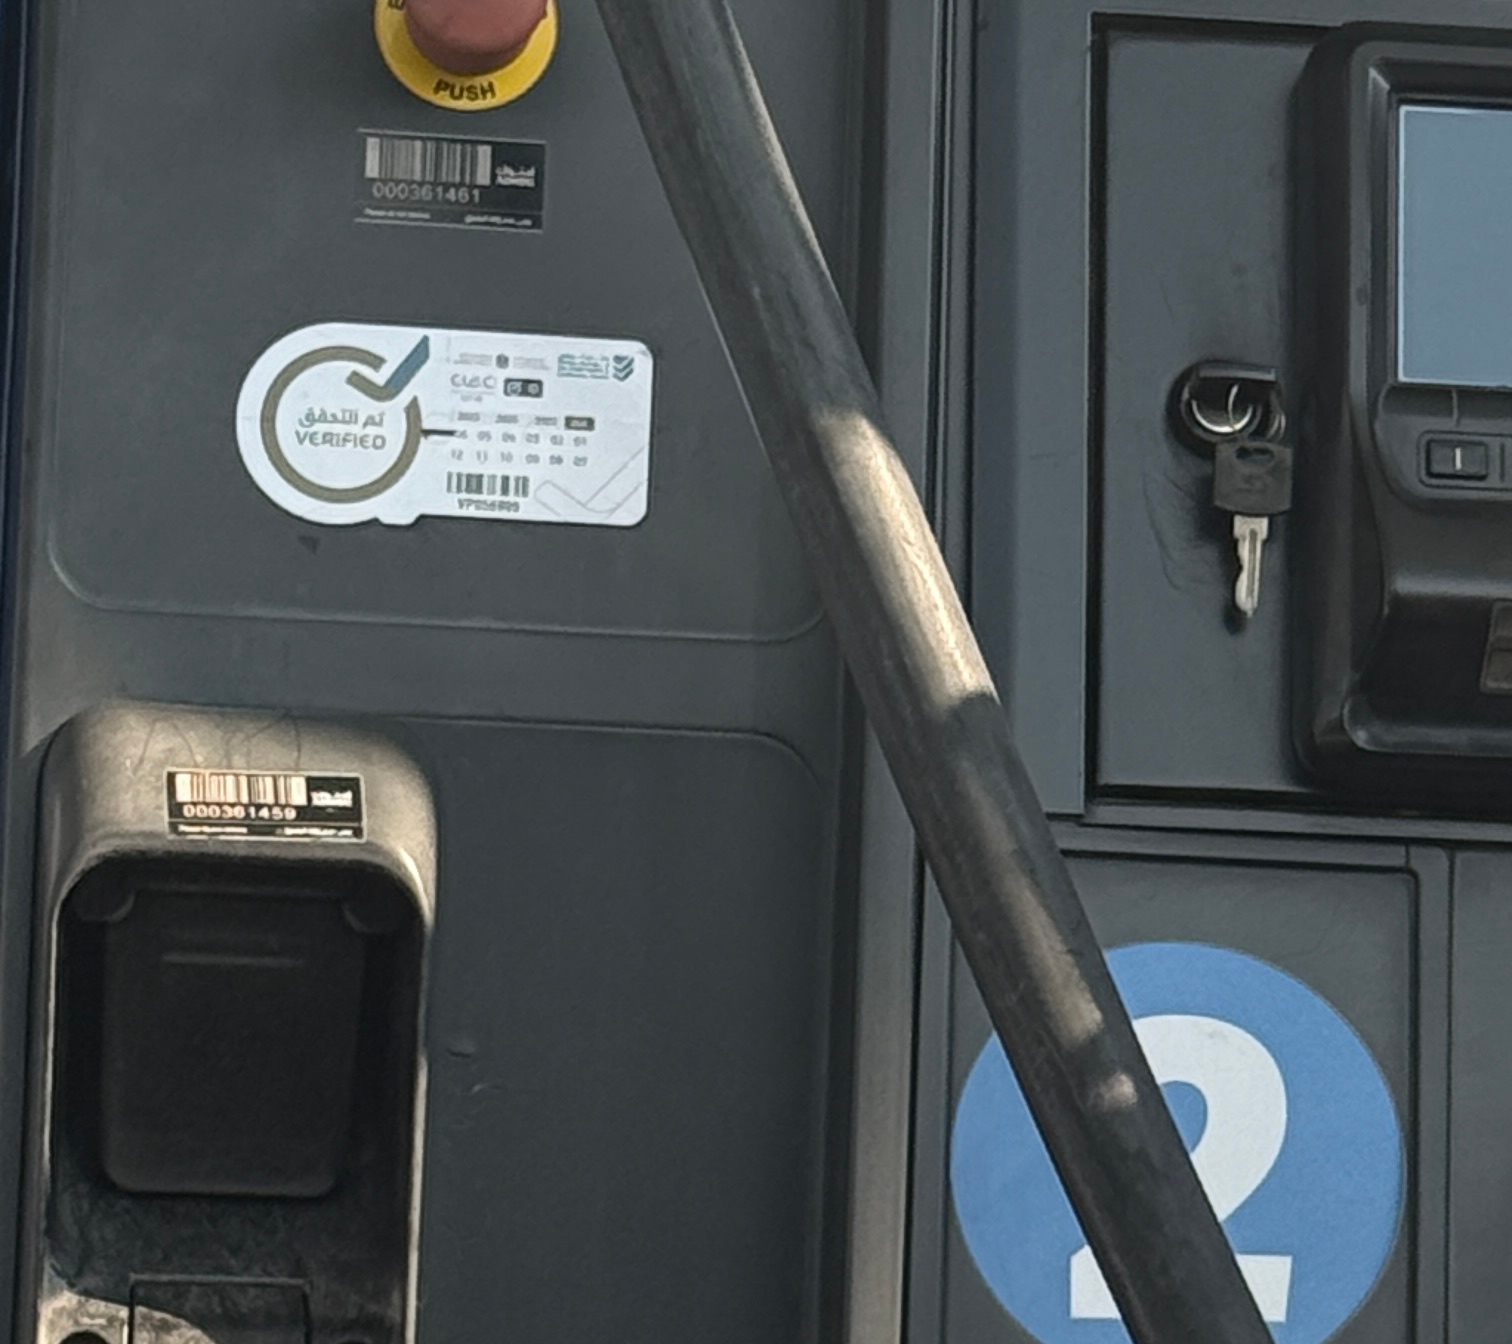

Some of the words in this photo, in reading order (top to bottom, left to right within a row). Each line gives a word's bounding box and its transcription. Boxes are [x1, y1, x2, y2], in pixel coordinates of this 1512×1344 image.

[433, 79, 496, 101] PUSH
[372, 181, 481, 204] 000361461
[298, 407, 359, 428] التحقق
[362, 412, 386, 429] تم
[295, 430, 387, 451] VERIFIED
